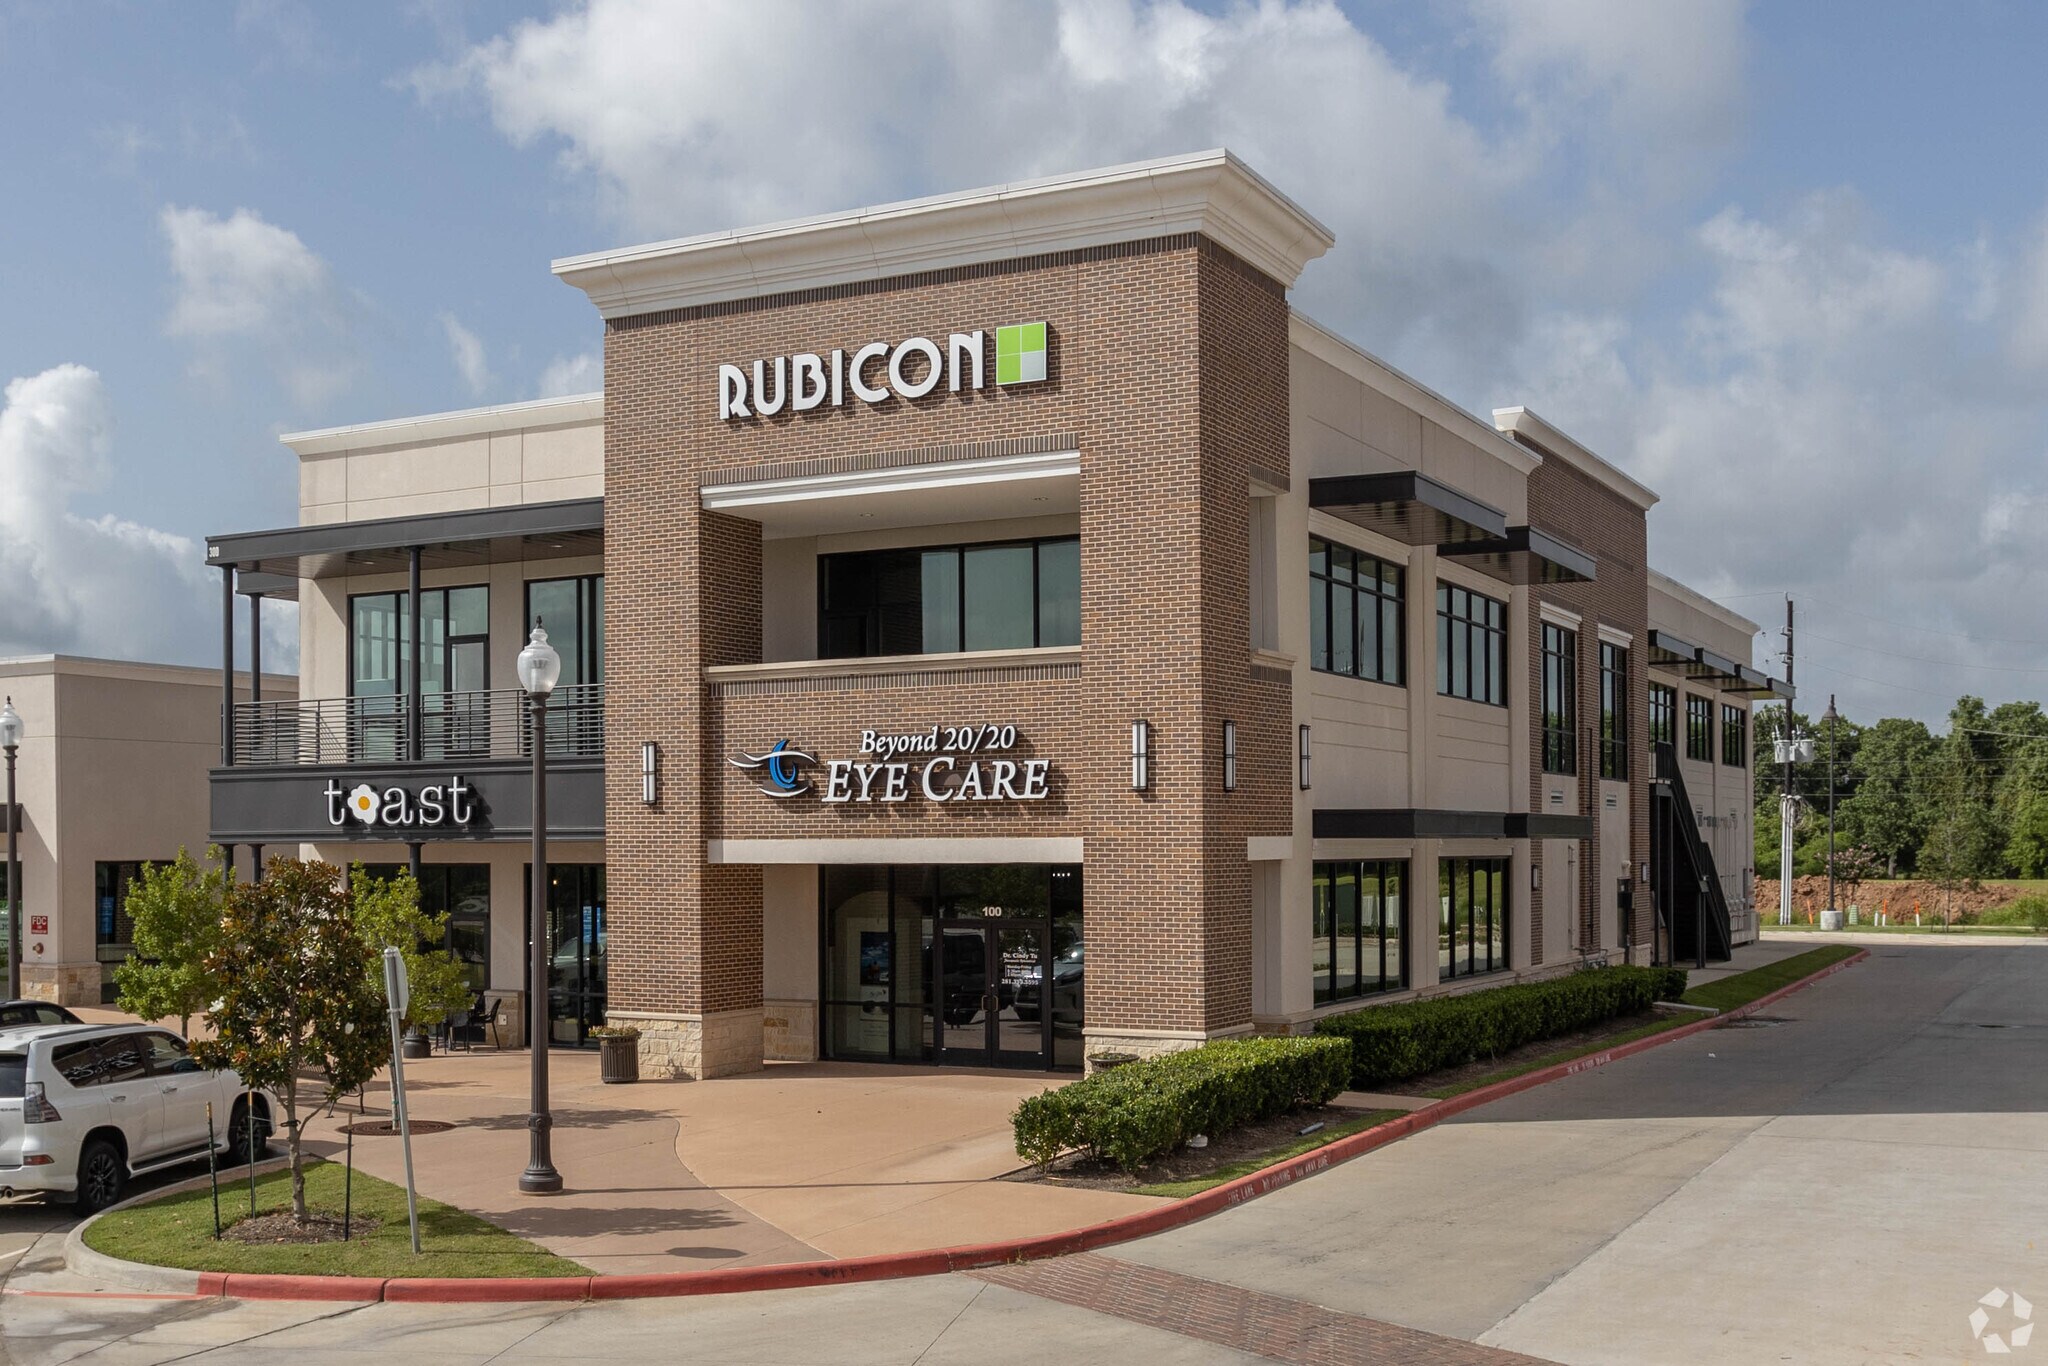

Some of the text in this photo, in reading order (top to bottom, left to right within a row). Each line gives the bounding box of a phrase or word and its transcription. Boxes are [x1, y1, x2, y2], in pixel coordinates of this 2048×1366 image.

[719, 330, 984, 420] RUBICON
[859, 724, 1016, 760] Beyond 20/20
[821, 756, 1050, 803] EYE CARE
[32, 916, 47, 926] FDC
[982, 906, 1002, 917] 100
